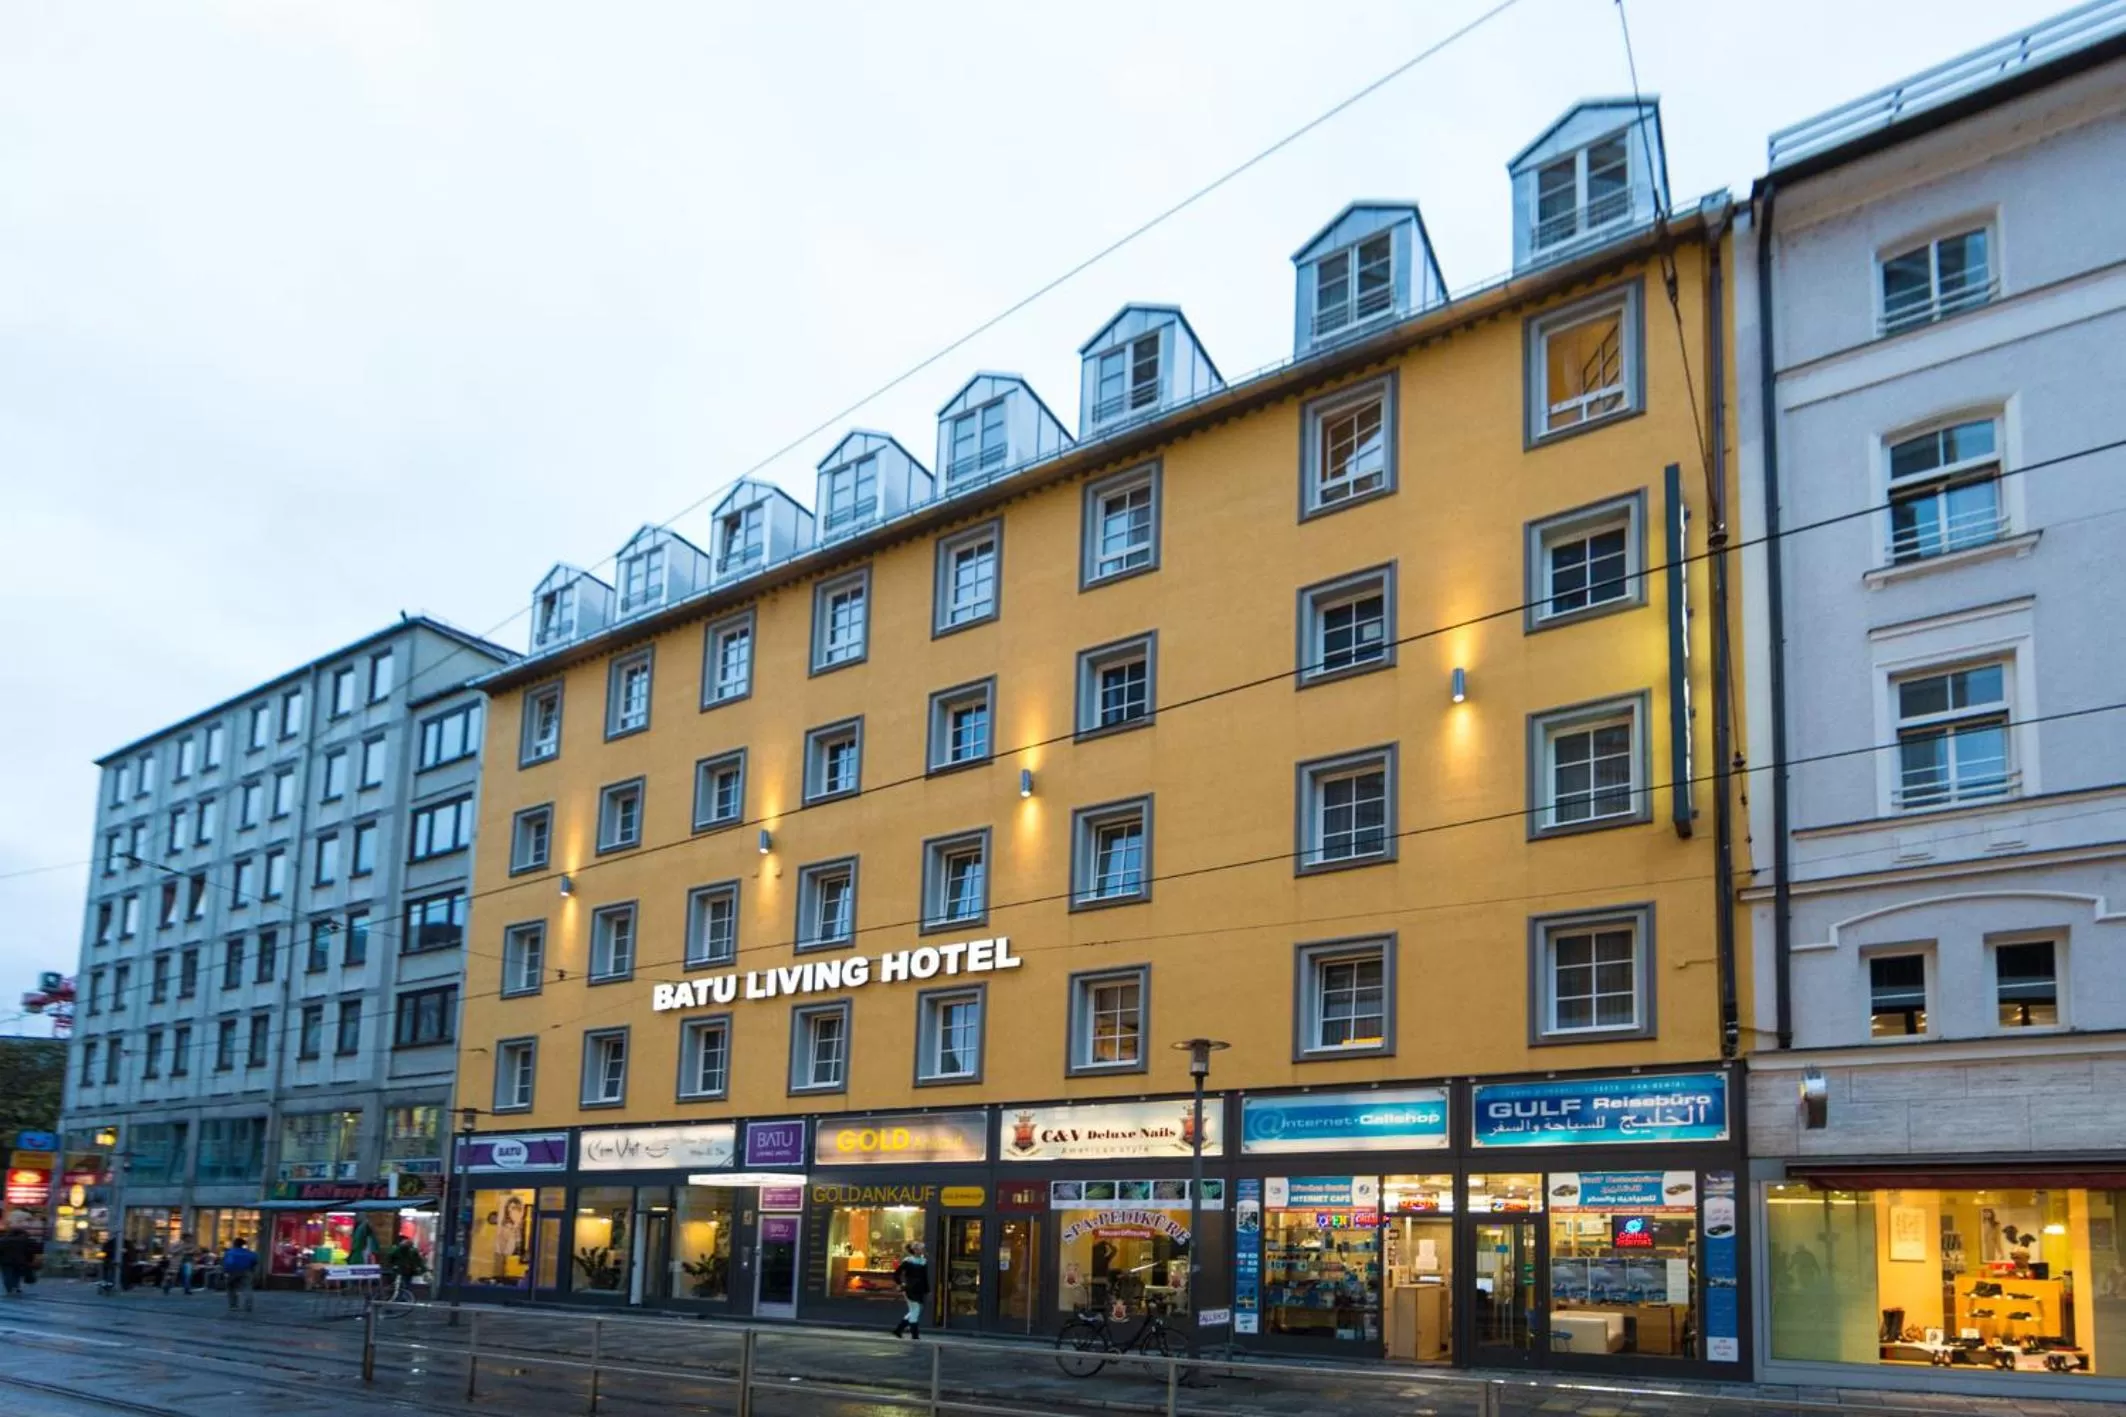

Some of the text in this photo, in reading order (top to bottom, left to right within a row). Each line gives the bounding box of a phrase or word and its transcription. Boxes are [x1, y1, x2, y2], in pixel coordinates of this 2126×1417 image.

[653, 936, 1021, 1011] BATU LIVING HOTEL
[1488, 1093, 1712, 1118] GULF Reisebüro
[756, 1131, 793, 1148] BATU
[836, 1127, 911, 1152] GOLD
[1041, 1127, 1176, 1143] C&V Deluxe Nails
[812, 1185, 934, 1203] GOLDANKAUF
